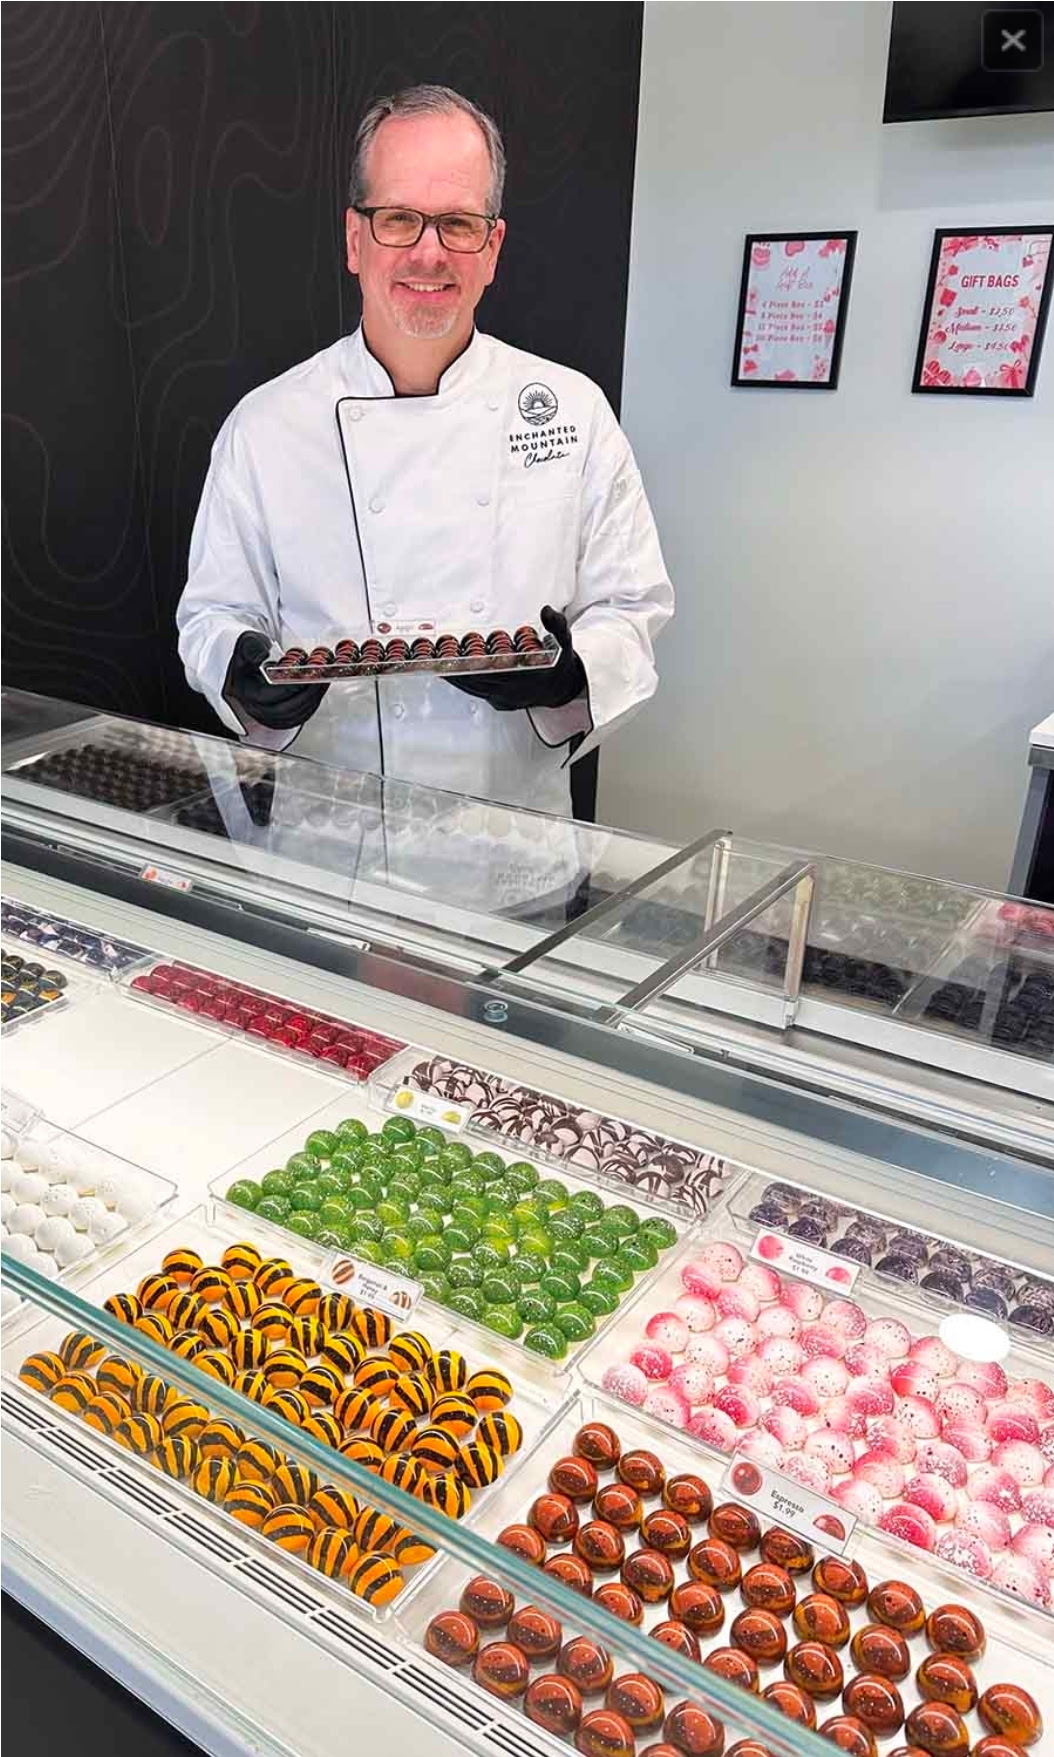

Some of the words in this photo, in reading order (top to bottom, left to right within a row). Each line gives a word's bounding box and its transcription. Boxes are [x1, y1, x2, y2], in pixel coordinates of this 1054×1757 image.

[961, 275, 986, 288] GIFT
[987, 274, 1019, 288] BAGS
[954, 306, 979, 318] Small
[945, 322, 982, 335] Medium
[948, 341, 974, 353] Large
[509, 425, 576, 443] ENCHANTED
[511, 435, 578, 453] MOUNTAIN
[770, 1489, 805, 1513] Espresso
[773, 1501, 796, 1518] $1.99
